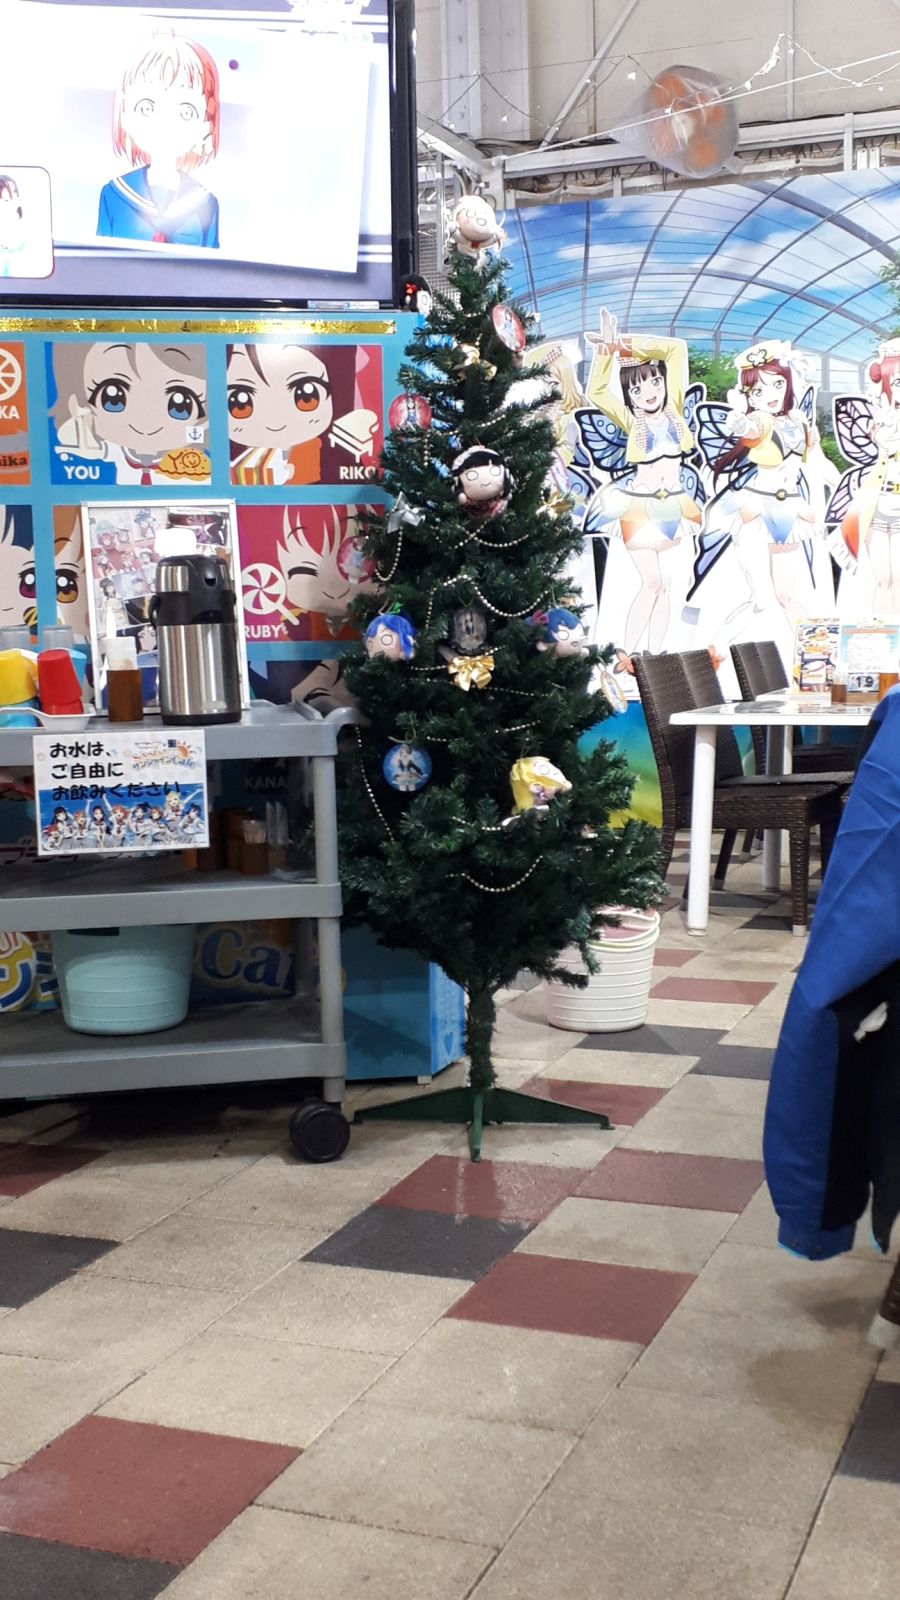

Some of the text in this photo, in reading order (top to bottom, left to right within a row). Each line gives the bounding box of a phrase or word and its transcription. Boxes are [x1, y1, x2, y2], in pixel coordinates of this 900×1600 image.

[0, 456, 28, 467] ika
[64, 465, 100, 480] YOU
[339, 466, 377, 480] RIKO
[244, 625, 282, 639] RUBY
[856, 676, 874, 688] 19
[50, 741, 113, 758] お水は、
[51, 762, 124, 779] ご自由に
[52, 781, 188, 801] お飲みください。
